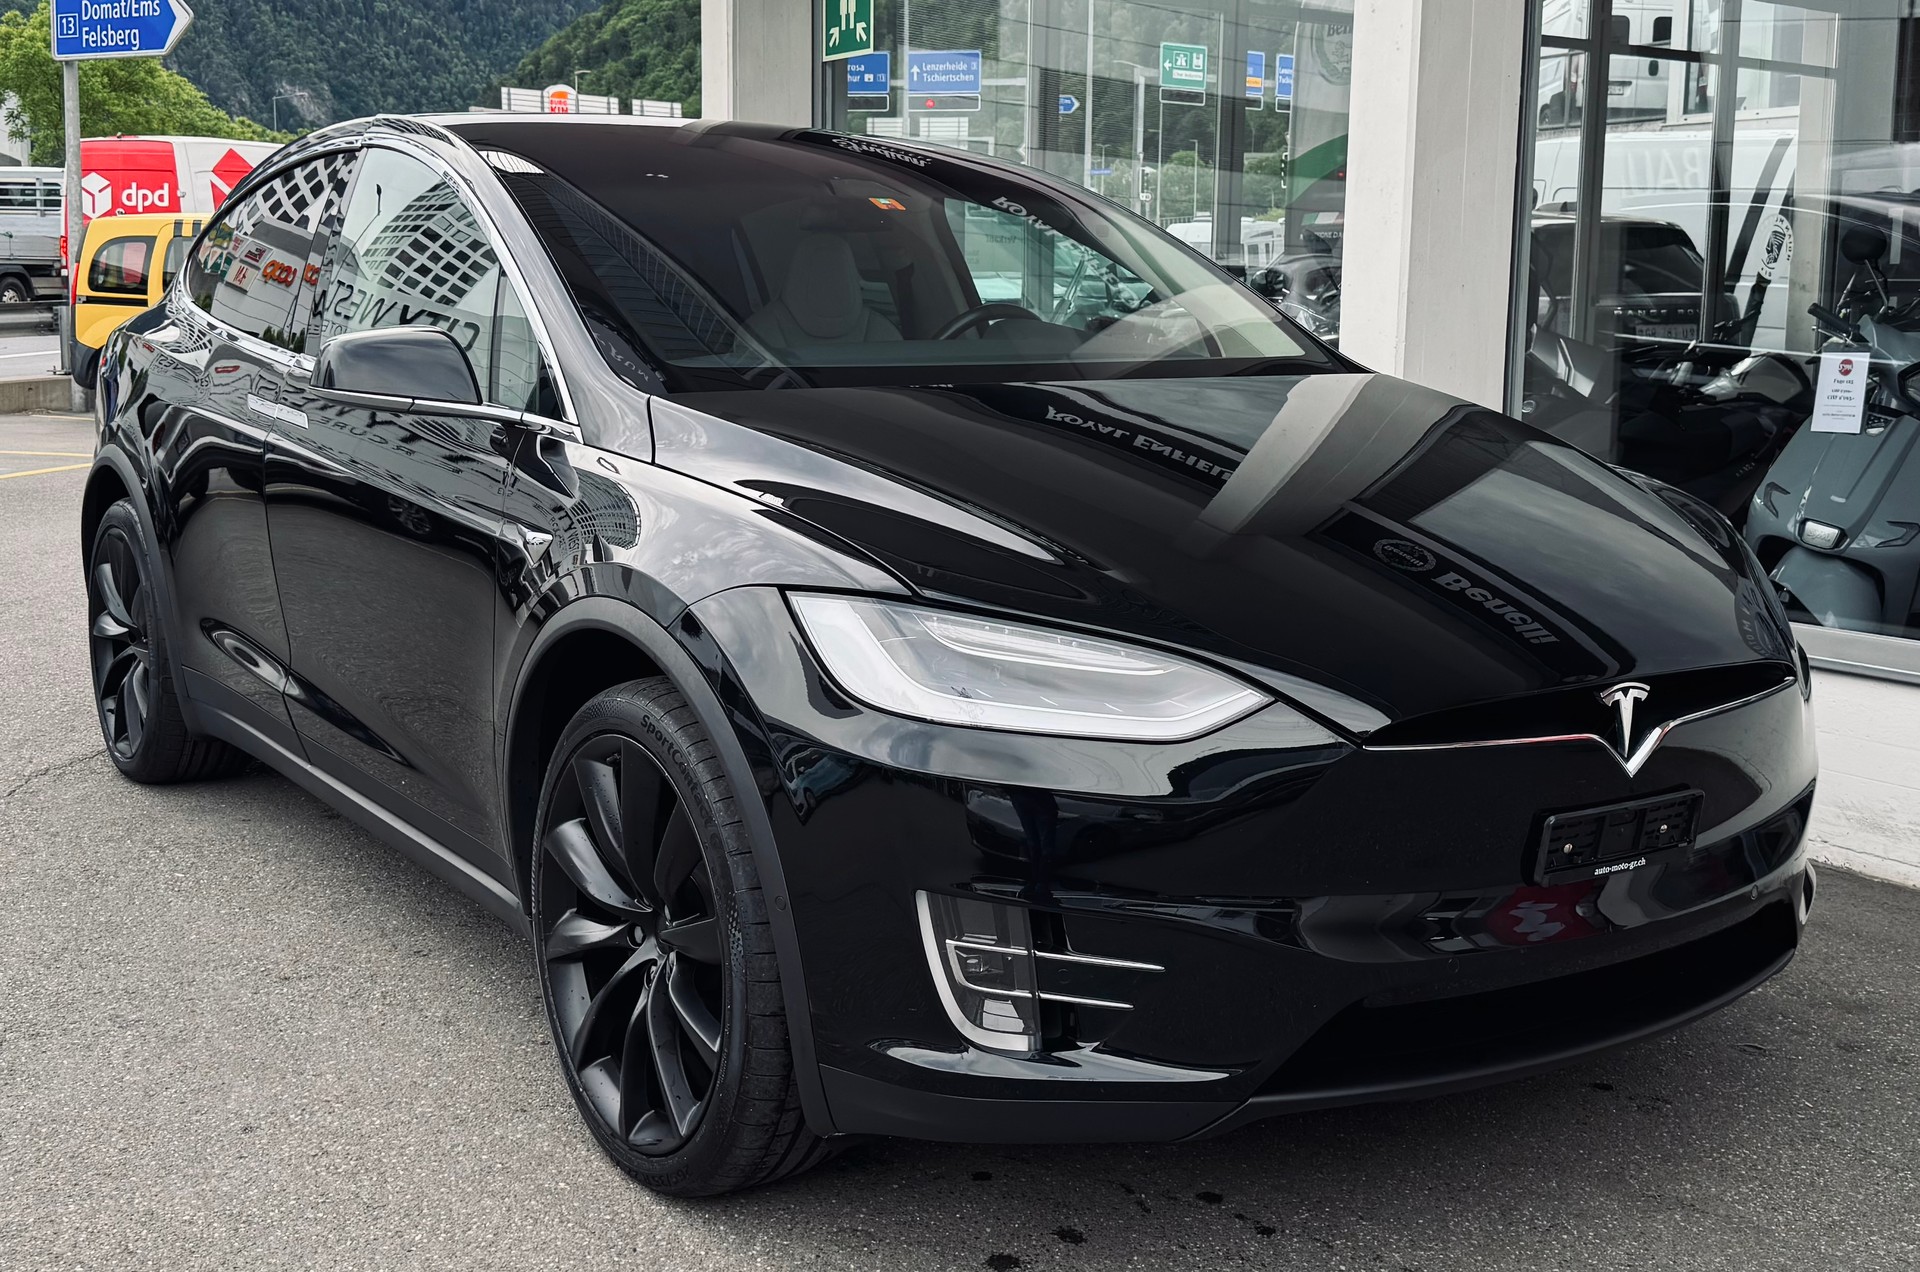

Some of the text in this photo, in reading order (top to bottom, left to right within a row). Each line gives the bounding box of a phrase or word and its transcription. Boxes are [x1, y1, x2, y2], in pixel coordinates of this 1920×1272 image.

[82, 0, 161, 20] Domat/Ems
[61, 17, 75, 35] 13
[82, 24, 140, 51] Felsberg
[922, 61, 968, 72] Lenzerheide
[922, 72, 975, 83] Tschiertschen
[121, 181, 169, 213] dpd
[1594, 857, 1646, 876] auto-moto-gr.ch
